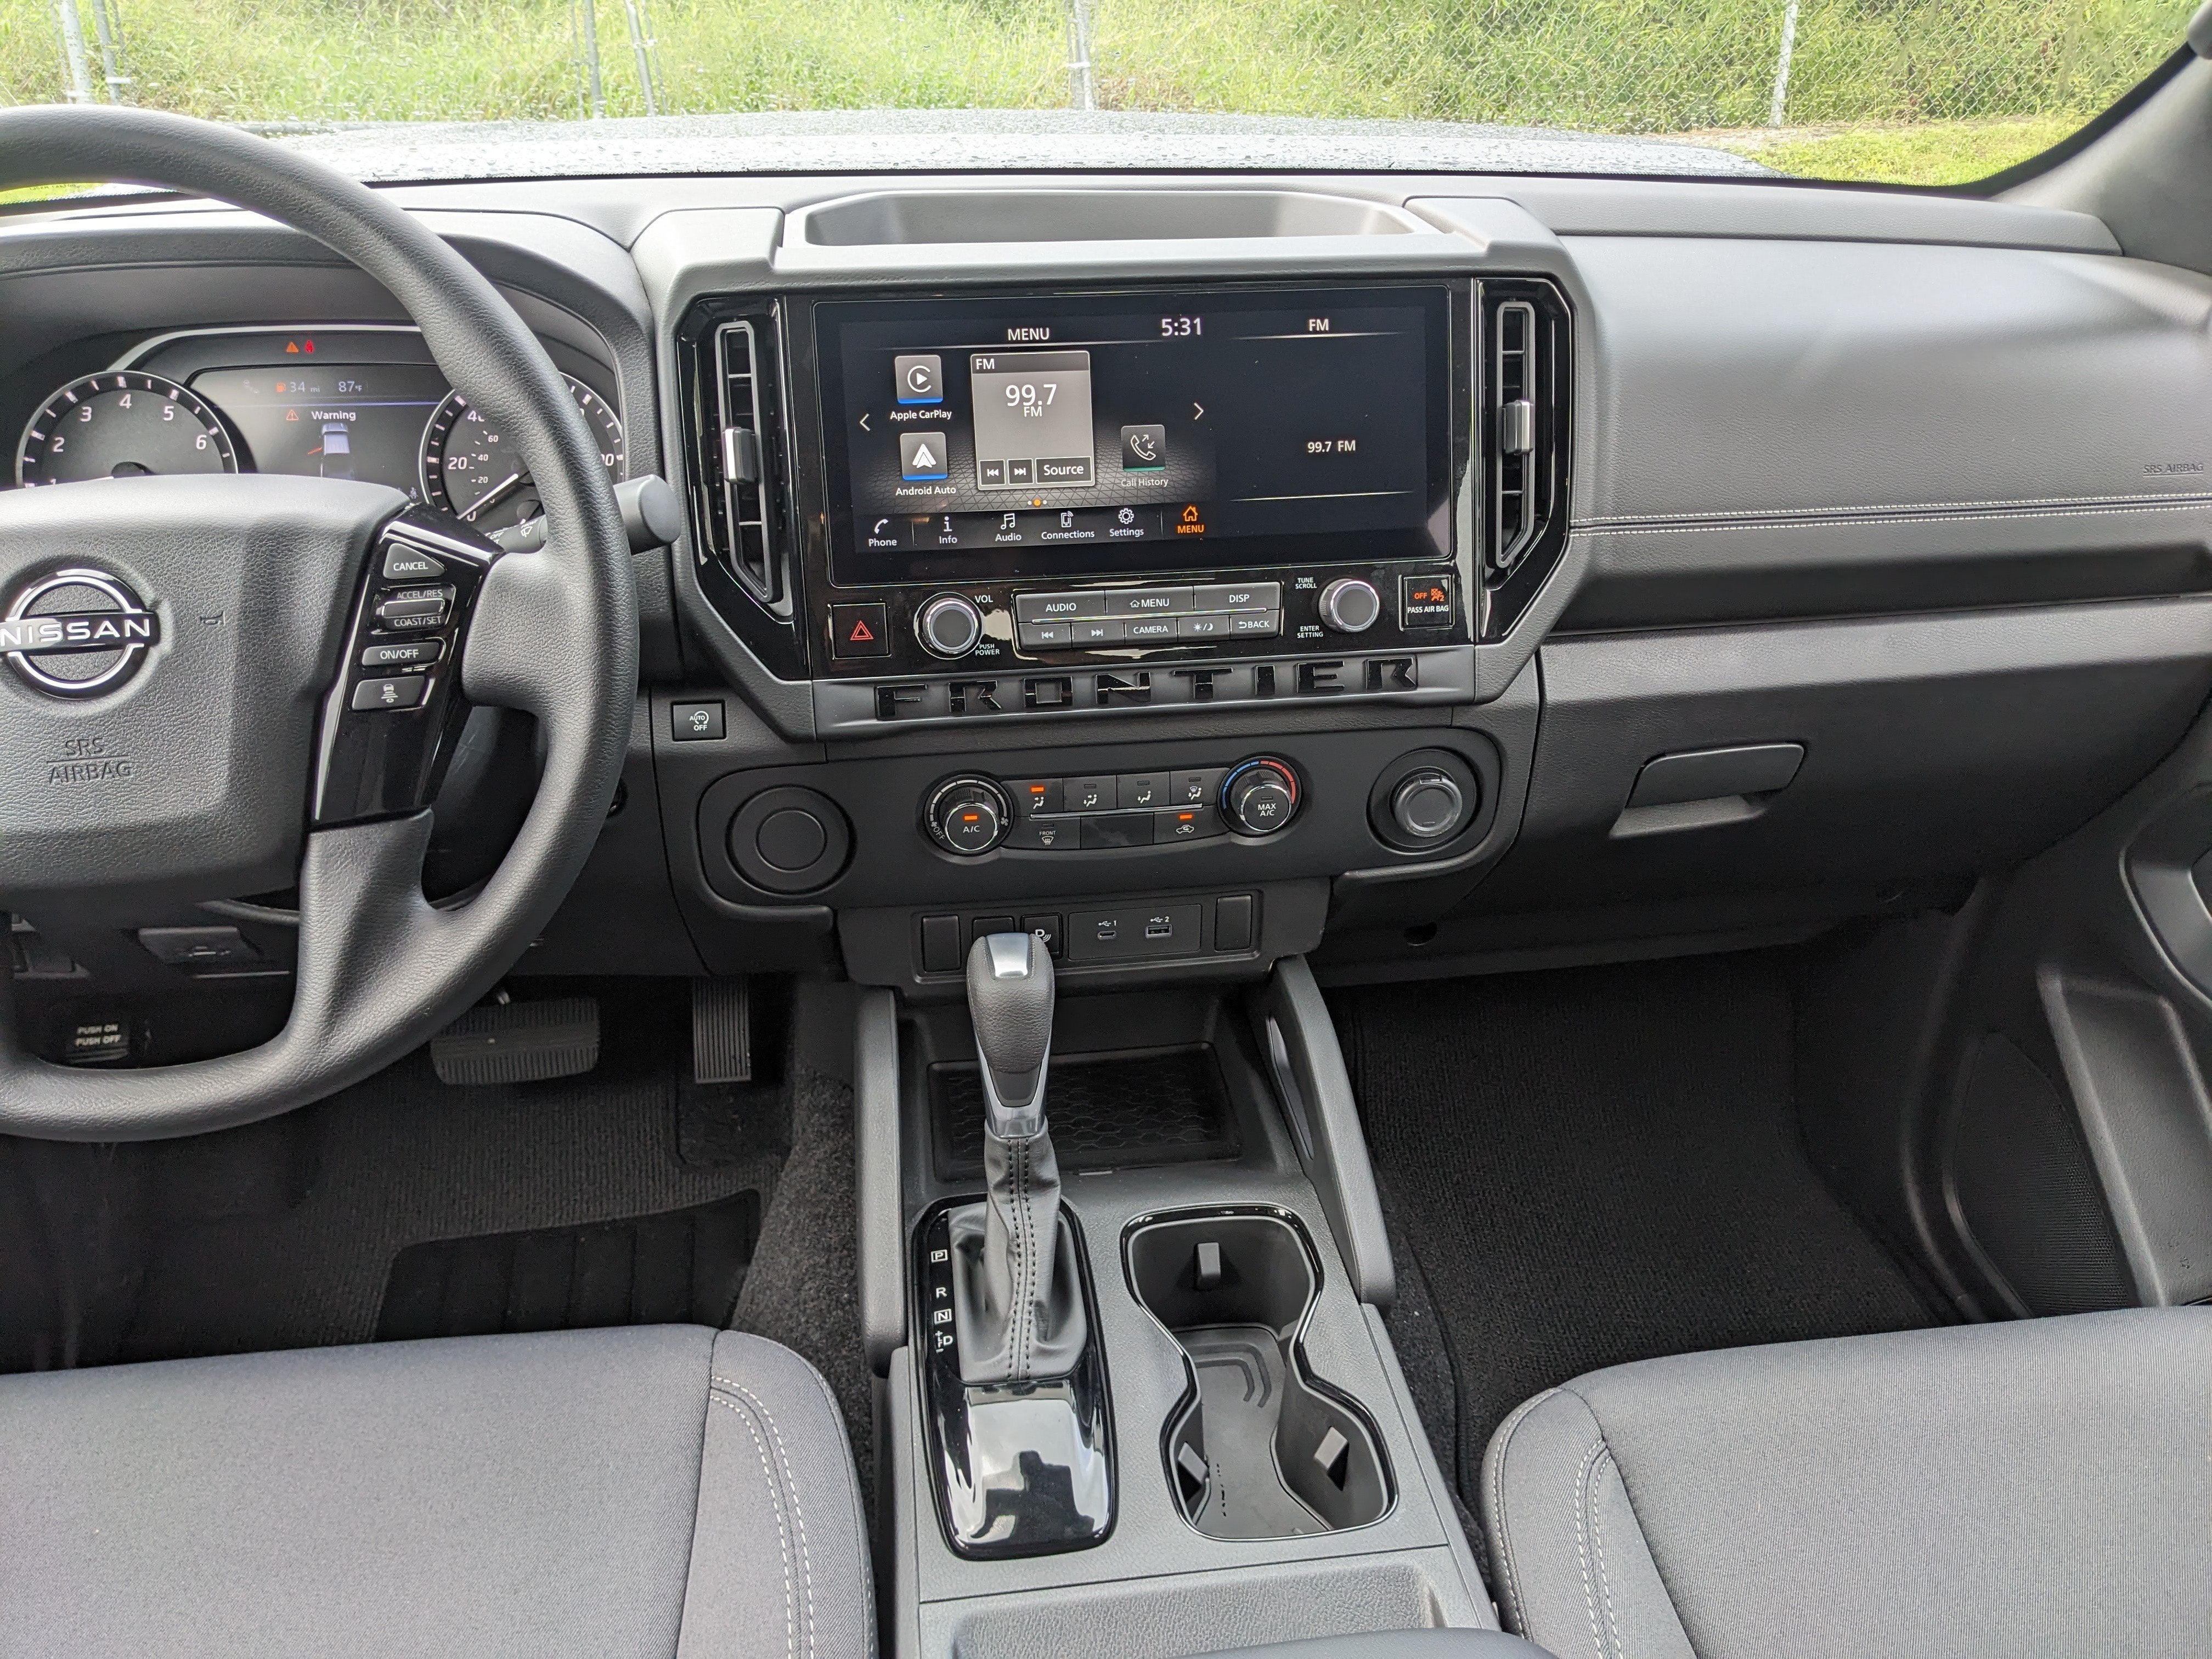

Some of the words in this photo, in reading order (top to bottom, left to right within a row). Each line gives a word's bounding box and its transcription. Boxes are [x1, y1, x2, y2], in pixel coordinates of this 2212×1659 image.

[1161, 317, 1201, 336] 5:31
[1309, 319, 1329, 331] FM
[1008, 328, 1050, 341] MENU
[975, 358, 995, 370] FM
[290, 382, 305, 392] 34
[1005, 383, 1057, 407] 99.7
[119, 393, 132, 409] 4
[80, 407, 92, 422] 3
[163, 406, 174, 421] 5
[311, 410, 356, 421] Warning
[890, 410, 917, 421] Apple
[919, 409, 952, 420] CarPlay
[1023, 406, 1042, 417] FM
[53, 437, 65, 453] 2
[195, 435, 207, 450] 6
[1307, 442, 1331, 453] 99.7
[1338, 440, 1356, 452] FM
[448, 457, 467, 470] 20
[2142, 464, 2162, 473] SRS
[2166, 463, 2204, 472] AIRBAG
[1043, 464, 1084, 477] Source
[1121, 479, 1137, 488] Call
[1138, 477, 1169, 488] History
[895, 486, 930, 495] Android
[934, 485, 956, 495] Auto
[1109, 528, 1144, 538] Settings
[1177, 523, 1204, 533] MENU
[939, 534, 957, 544] Info
[995, 532, 1022, 541] Audio
[1041, 529, 1095, 540] Connections
[868, 537, 897, 546] Phone
[393, 561, 428, 572] CANCEL
[397, 589, 443, 600] ACCEL/RES
[975, 595, 994, 603] VOL
[1229, 594, 1250, 603] DISP
[1045, 602, 1076, 612] AUDIO
[1141, 597, 1170, 608] MENU
[394, 616, 442, 627] COAST/SET
[1248, 619, 1270, 629] BACK
[0, 619, 150, 647] NISSAN
[1133, 624, 1169, 635] CAMERA
[380, 649, 419, 659] ON/OFF
[876, 657, 1417, 720] FRONTIER
[65, 738, 106, 757] SRS
[49, 761, 133, 784] AIRBAG
[1257, 803, 1276, 812] MAX
[933, 827, 945, 840] OFF
[963, 825, 980, 833] A/C
[77, 1026, 102, 1035] PUSH
[104, 1024, 119, 1032] ON
[75, 1036, 100, 1046] PUSH
[103, 1034, 121, 1044] OFF
[935, 1252, 944, 1260] P
[936, 1286, 947, 1299] R
[937, 1312, 948, 1321] N
[943, 1335, 953, 1346] D
